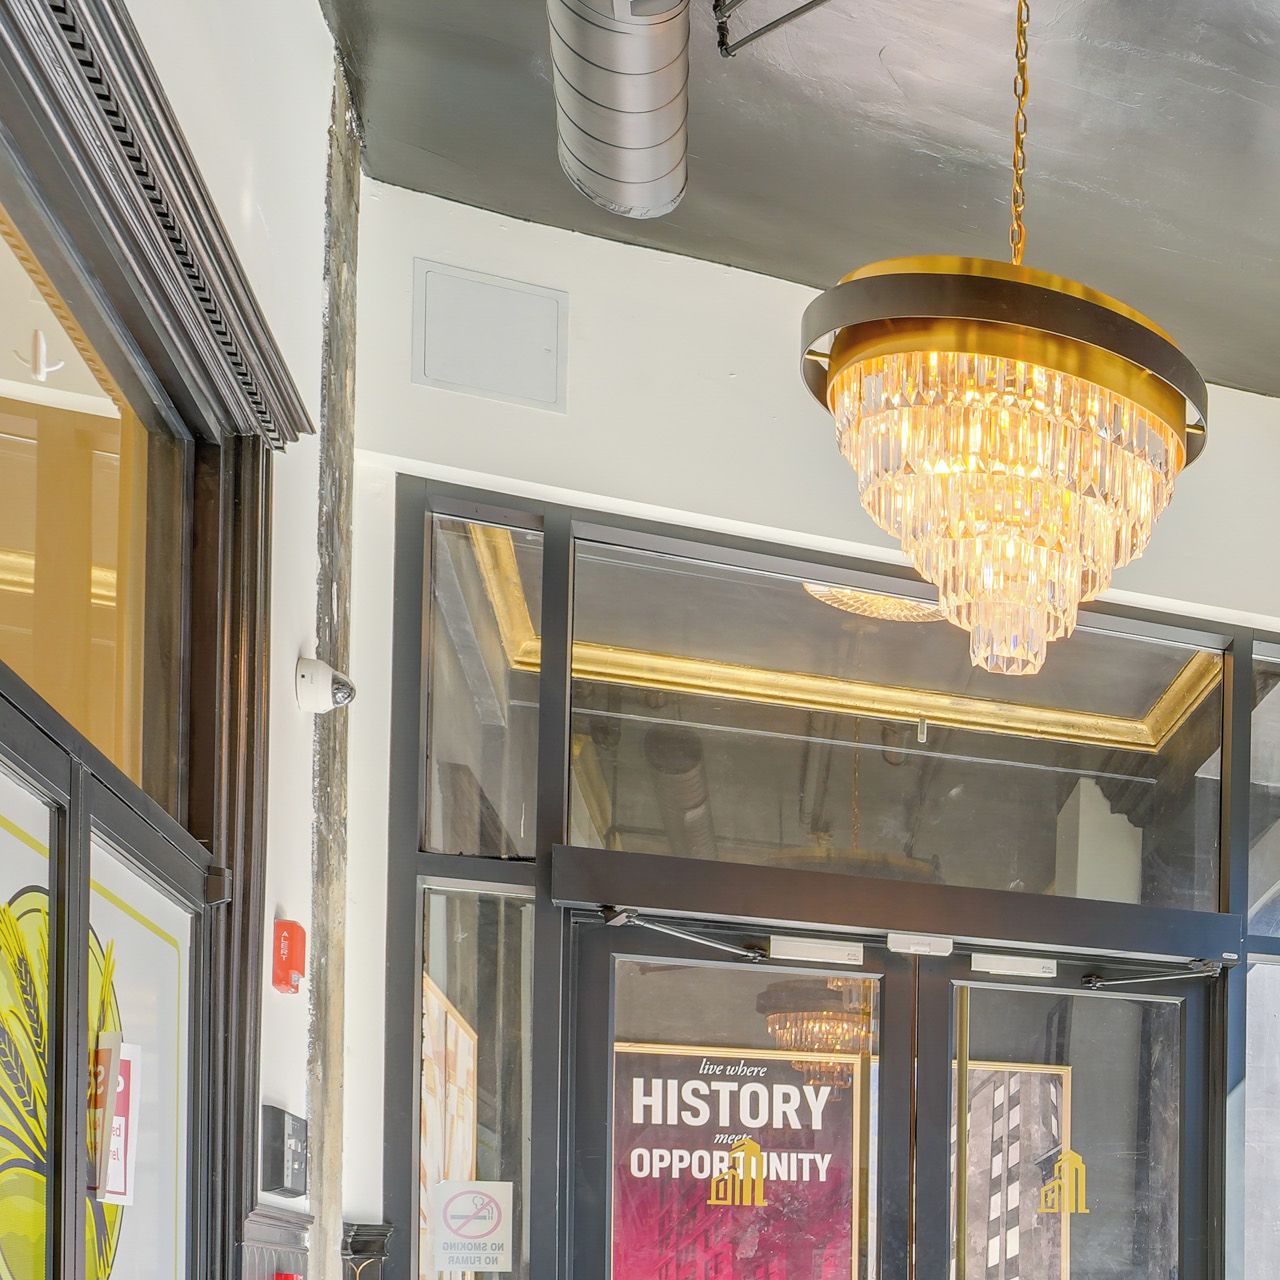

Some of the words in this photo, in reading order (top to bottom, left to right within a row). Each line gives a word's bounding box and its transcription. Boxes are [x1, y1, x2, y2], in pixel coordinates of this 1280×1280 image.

[280, 930, 289, 961] ALERT
[699, 1058, 723, 1075] live
[726, 1060, 767, 1077] where
[632, 1077, 832, 1130] HISTORY
[630, 1148, 832, 1182] OPPORTUNITY
